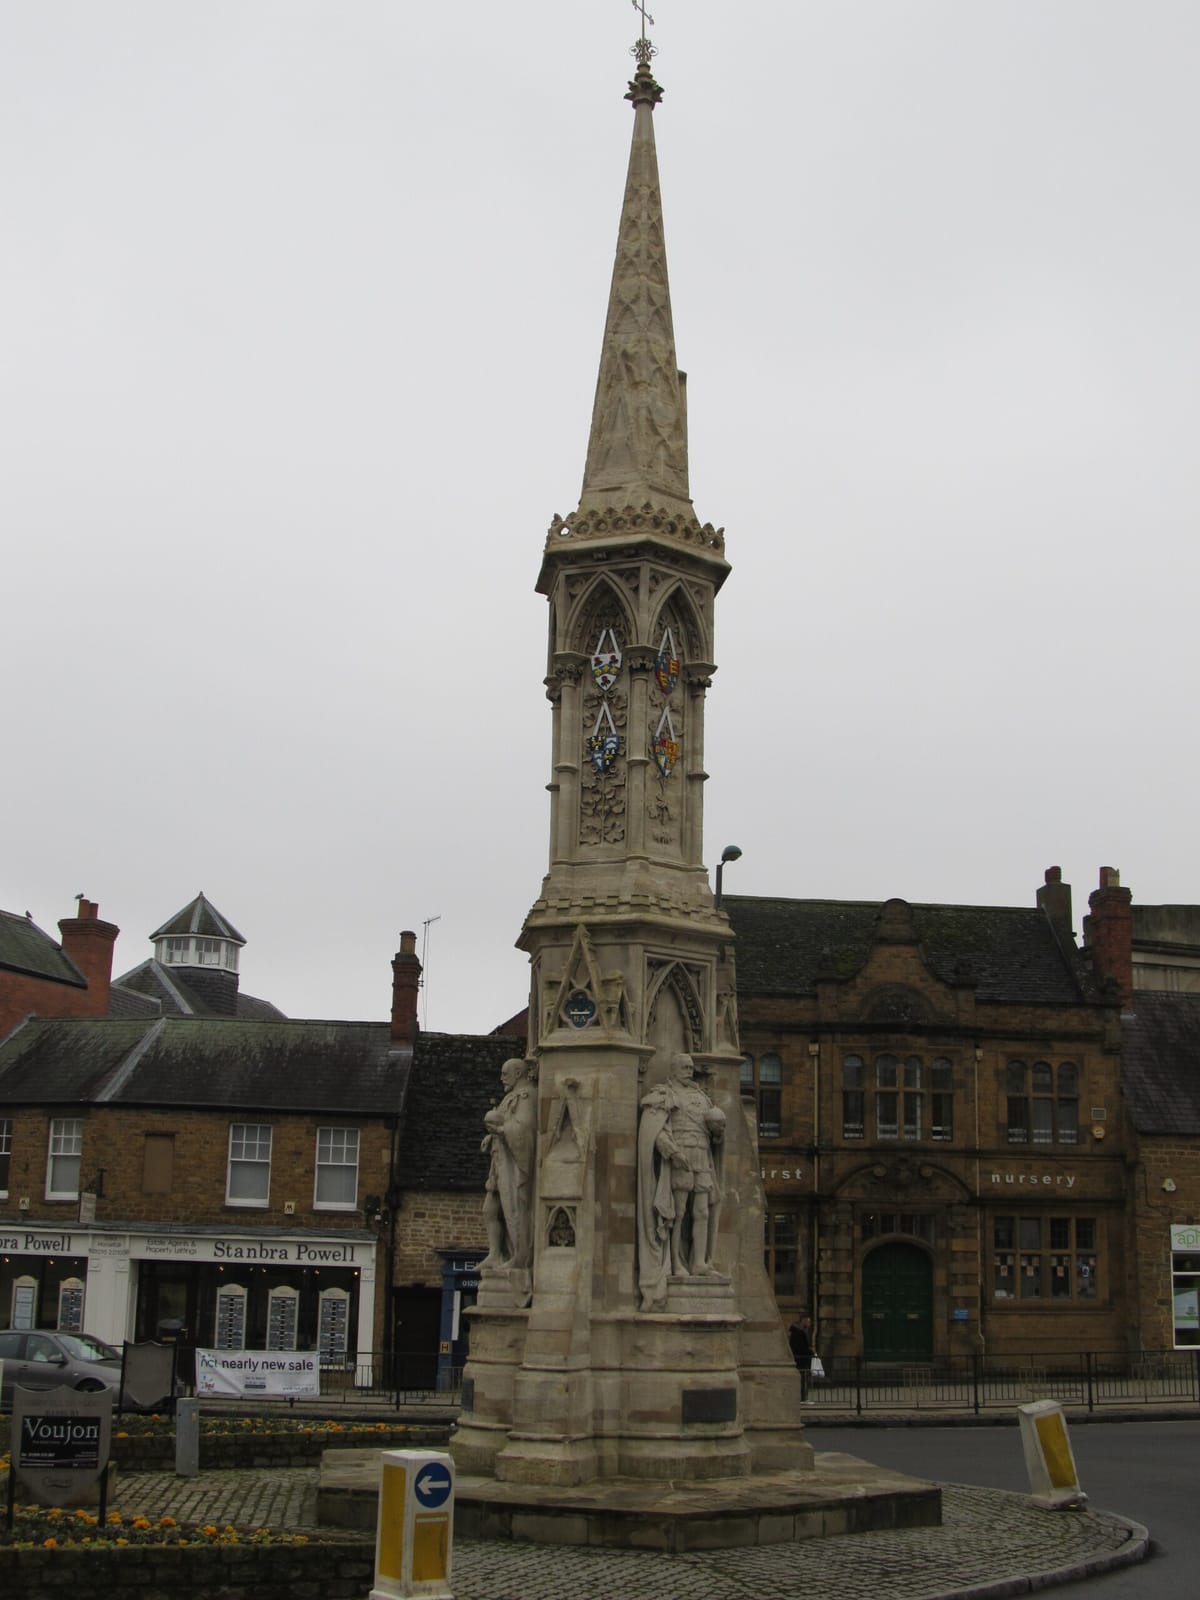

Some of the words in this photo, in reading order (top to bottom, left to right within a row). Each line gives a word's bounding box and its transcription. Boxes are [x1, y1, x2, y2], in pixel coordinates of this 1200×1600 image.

[991, 1174, 1076, 1188] nursery
[24, 1233, 72, 1252] Powell
[213, 1240, 288, 1260] Stanbra
[295, 1243, 355, 1262] Powell
[441, 1343, 449, 1351] H
[222, 1358, 259, 1372] nearly
[261, 1361, 287, 1371] new
[288, 1359, 314, 1371] sale
[24, 1418, 99, 1445] Voujon
